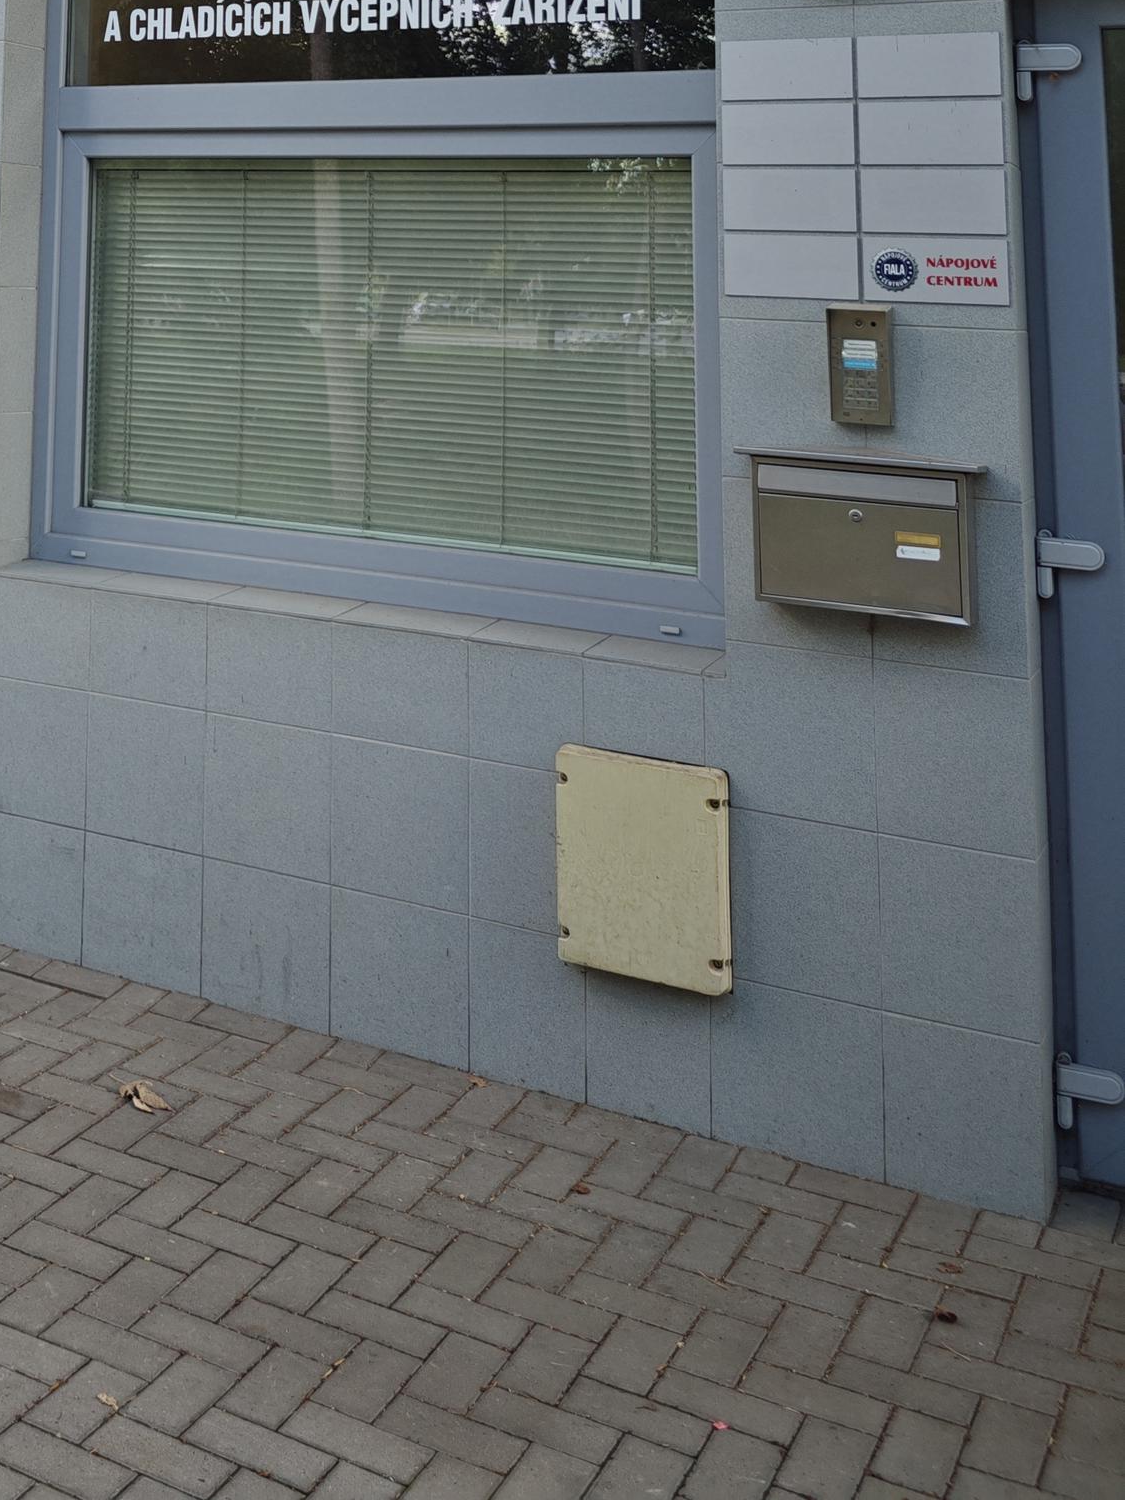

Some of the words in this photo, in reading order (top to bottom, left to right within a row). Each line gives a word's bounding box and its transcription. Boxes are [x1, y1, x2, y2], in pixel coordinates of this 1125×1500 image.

[104, 11, 122, 43] A
[883, 263, 905, 275] FIALA
[926, 255, 997, 270] NÁPOJOVÉ
[926, 275, 998, 287] CENTRUM
